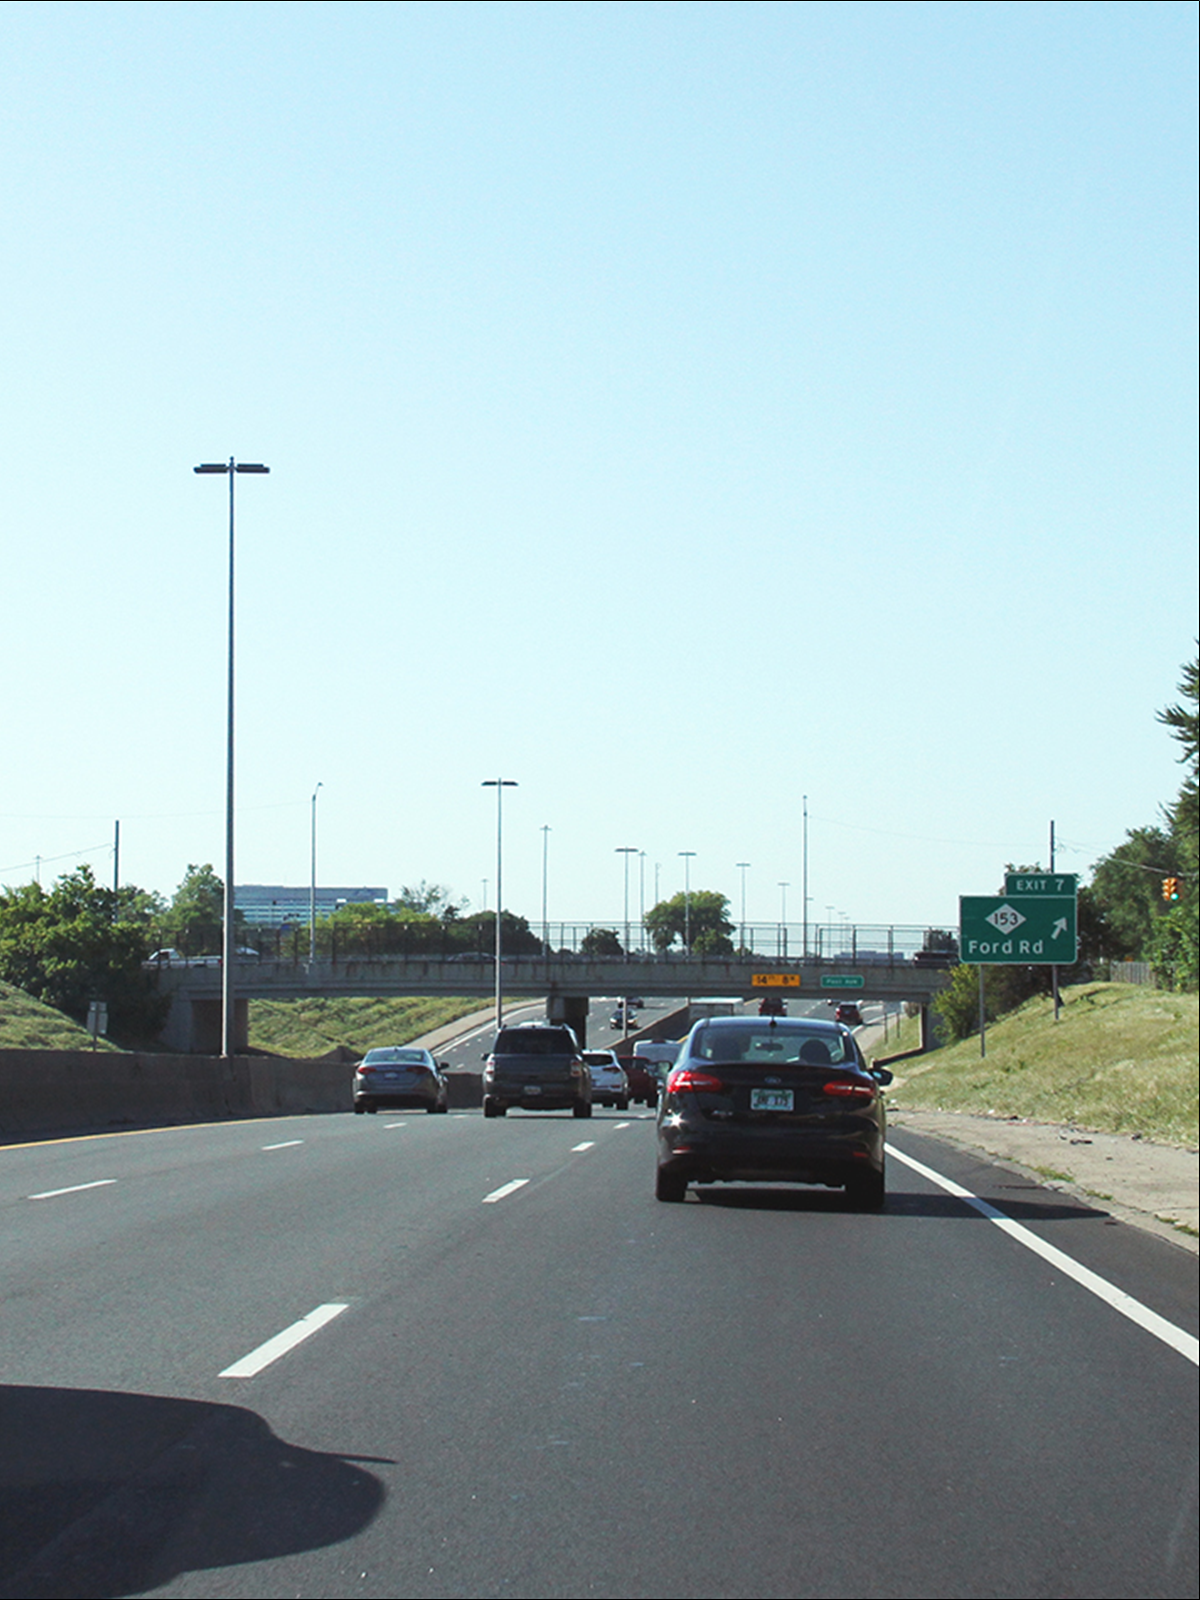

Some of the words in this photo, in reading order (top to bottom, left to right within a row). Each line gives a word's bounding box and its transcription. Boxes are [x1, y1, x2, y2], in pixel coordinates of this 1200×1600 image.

[1016, 879, 1048, 891] EXIT
[1055, 878, 1064, 891] 7
[994, 912, 1019, 926] 153
[968, 939, 1013, 954] Ford
[1019, 939, 1044, 954] Rd
